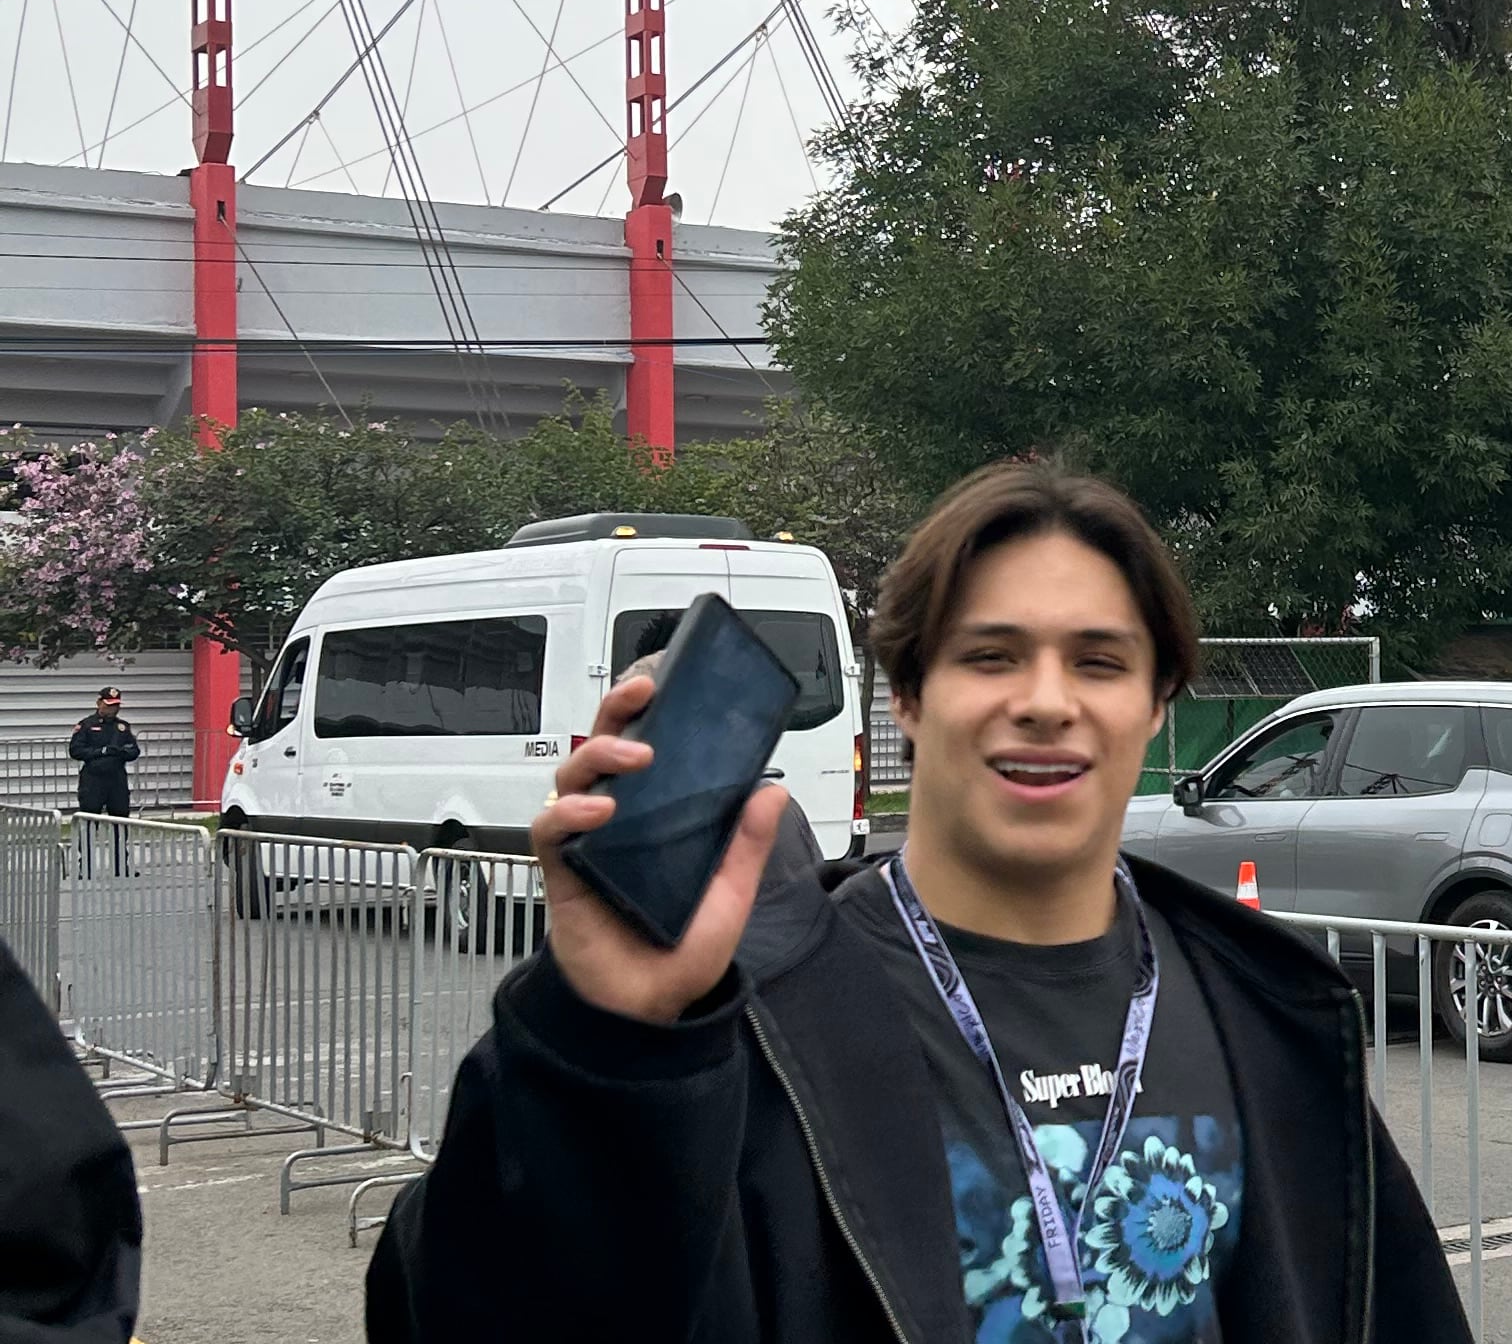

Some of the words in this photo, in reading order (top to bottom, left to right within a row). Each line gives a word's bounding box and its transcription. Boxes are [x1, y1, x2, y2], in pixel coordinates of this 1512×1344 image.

[525, 741, 559, 757] MEDIA
[1020, 1070, 1081, 1109] Super
[1035, 1186, 1062, 1249] FRIDAY
